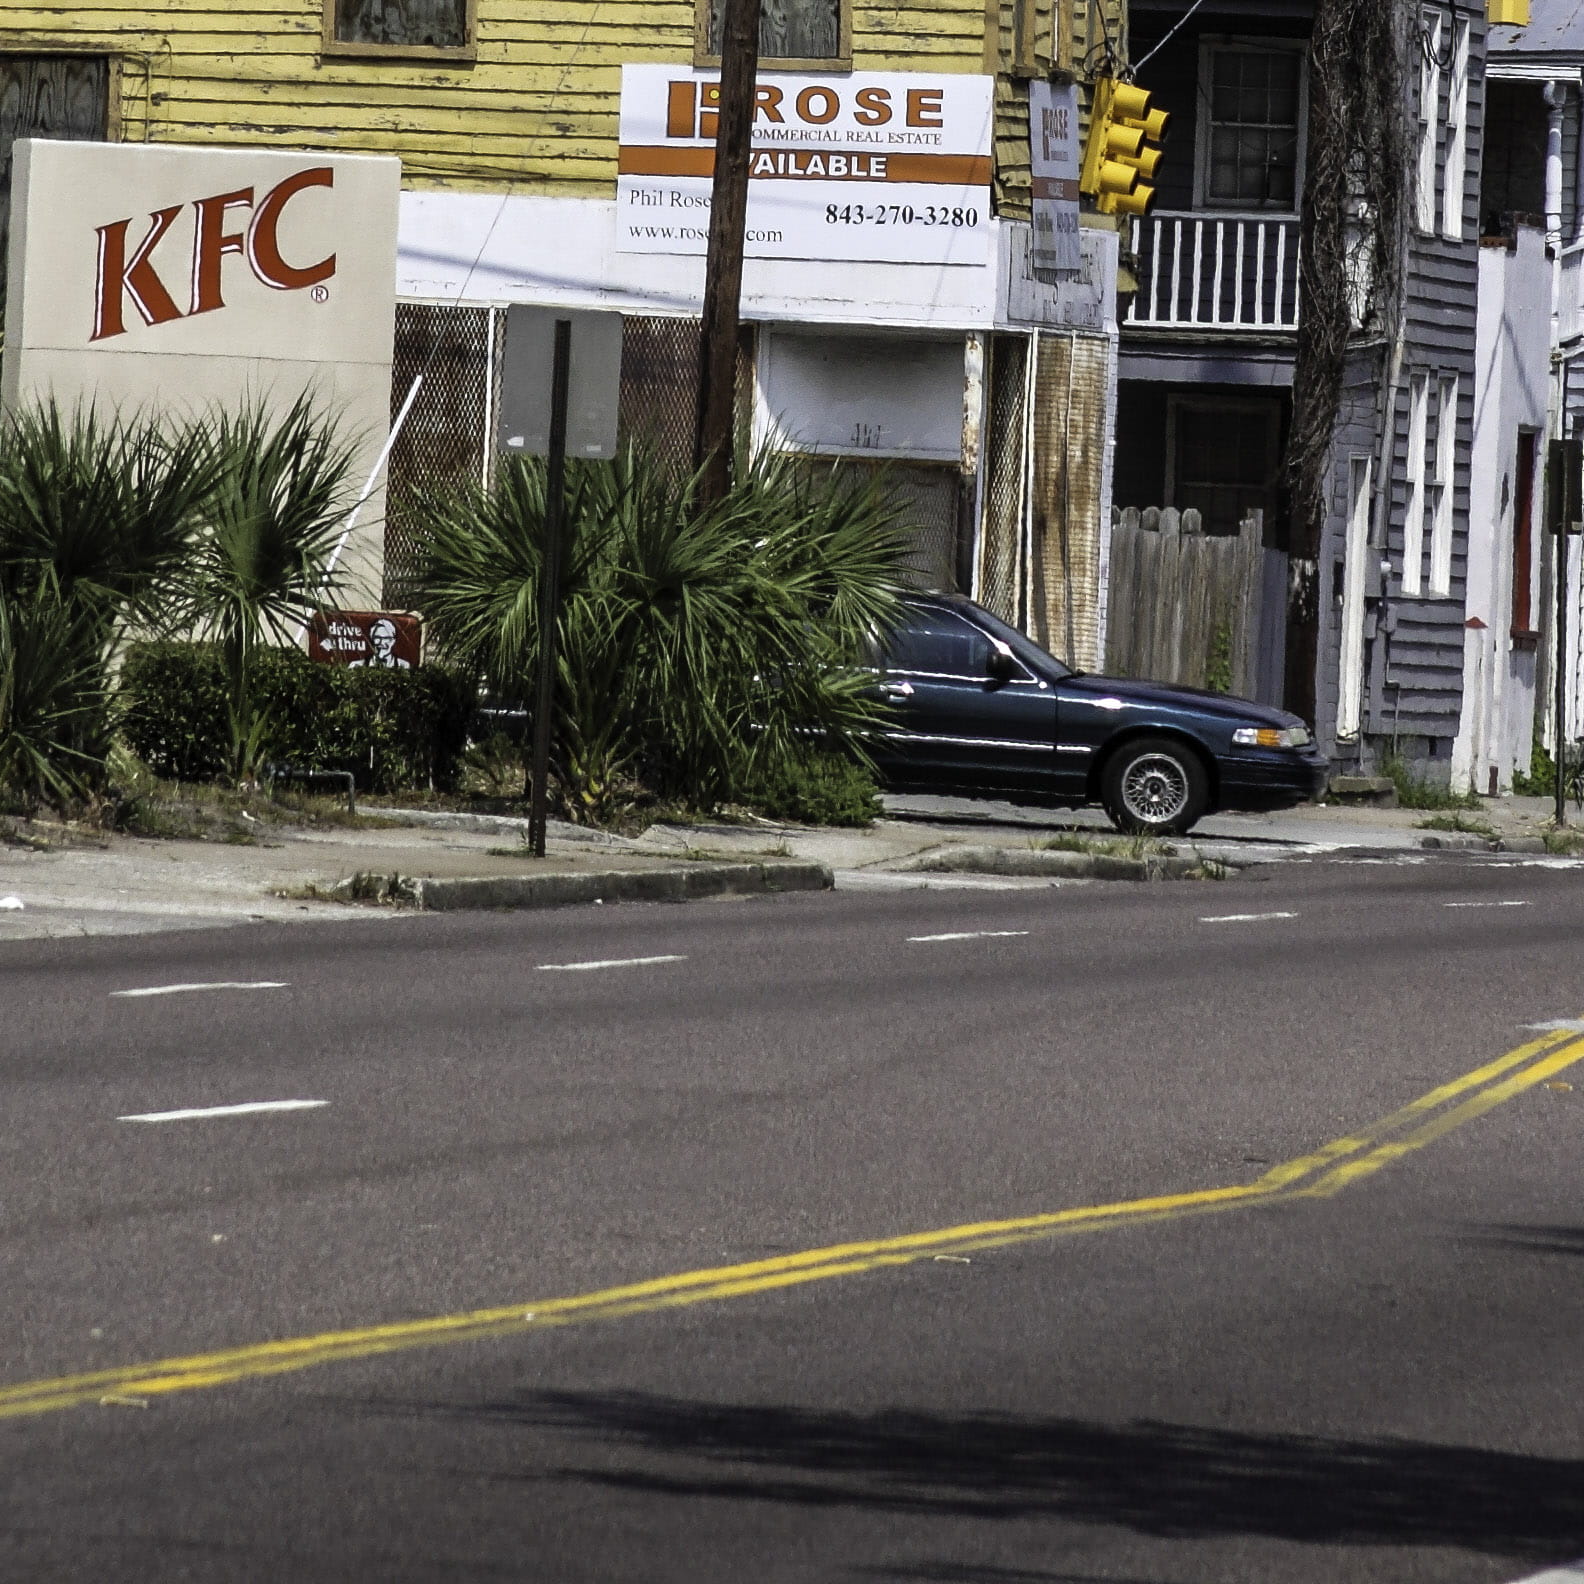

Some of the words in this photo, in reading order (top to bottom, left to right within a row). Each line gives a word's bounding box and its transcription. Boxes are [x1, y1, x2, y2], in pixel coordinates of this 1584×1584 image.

[751, 85, 944, 128] ROSE
[751, 129, 841, 143] OMMERCIAL
[846, 130, 883, 143] REAL
[888, 131, 942, 146] ESTATE
[750, 152, 888, 178] AILABLE
[630, 189, 663, 206] Phil
[825, 202, 978, 228] 843-270-3280
[88, 167, 336, 342] KFC
[329, 621, 362, 636] drive
[338, 637, 366, 651] thru
